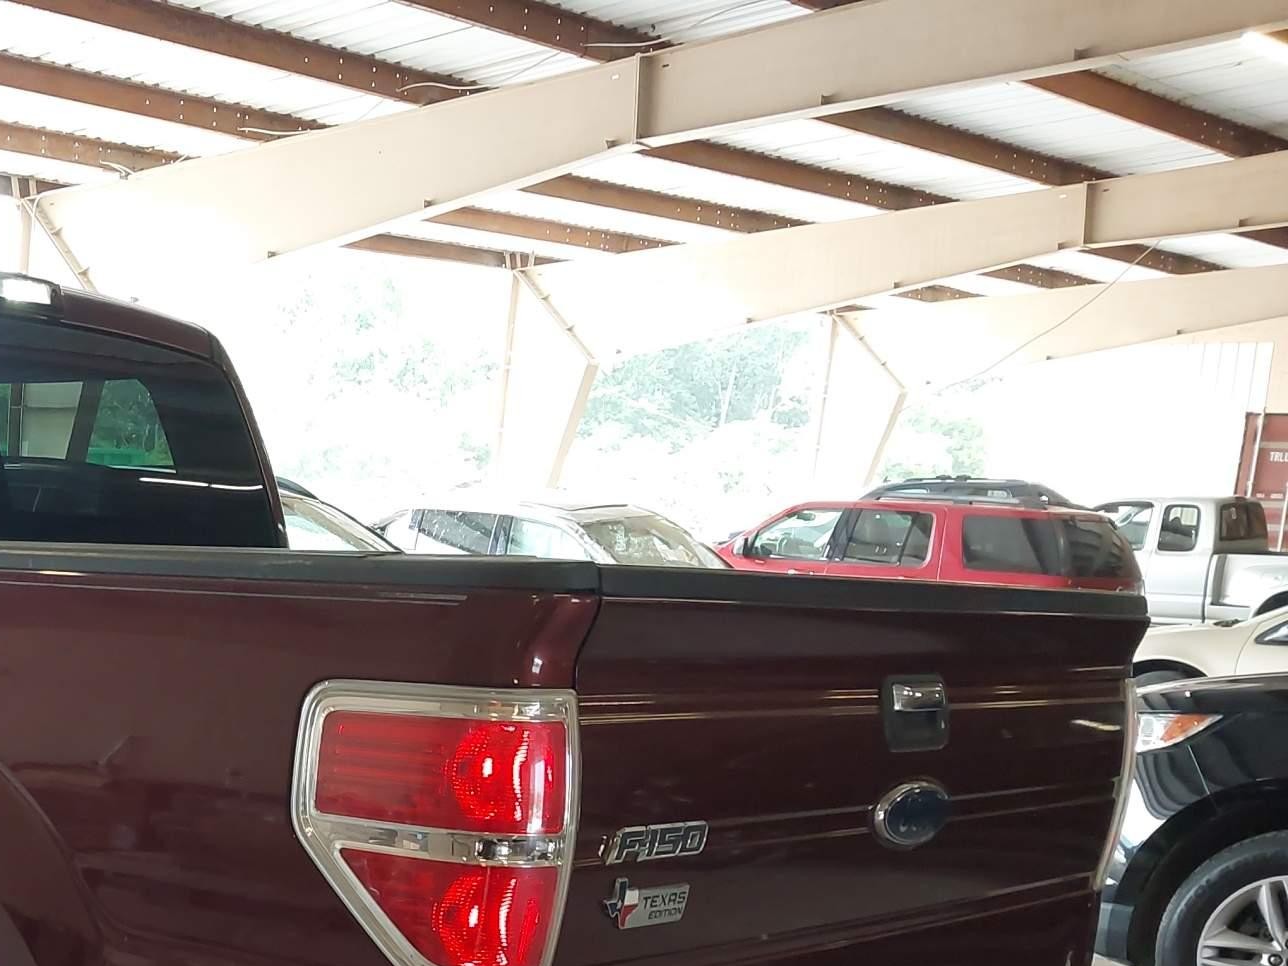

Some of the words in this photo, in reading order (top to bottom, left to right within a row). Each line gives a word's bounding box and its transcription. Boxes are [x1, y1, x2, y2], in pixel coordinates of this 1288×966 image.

[606, 821, 708, 864] F-150
[643, 891, 687, 909] TEXAS
[648, 907, 683, 919] EDITION
